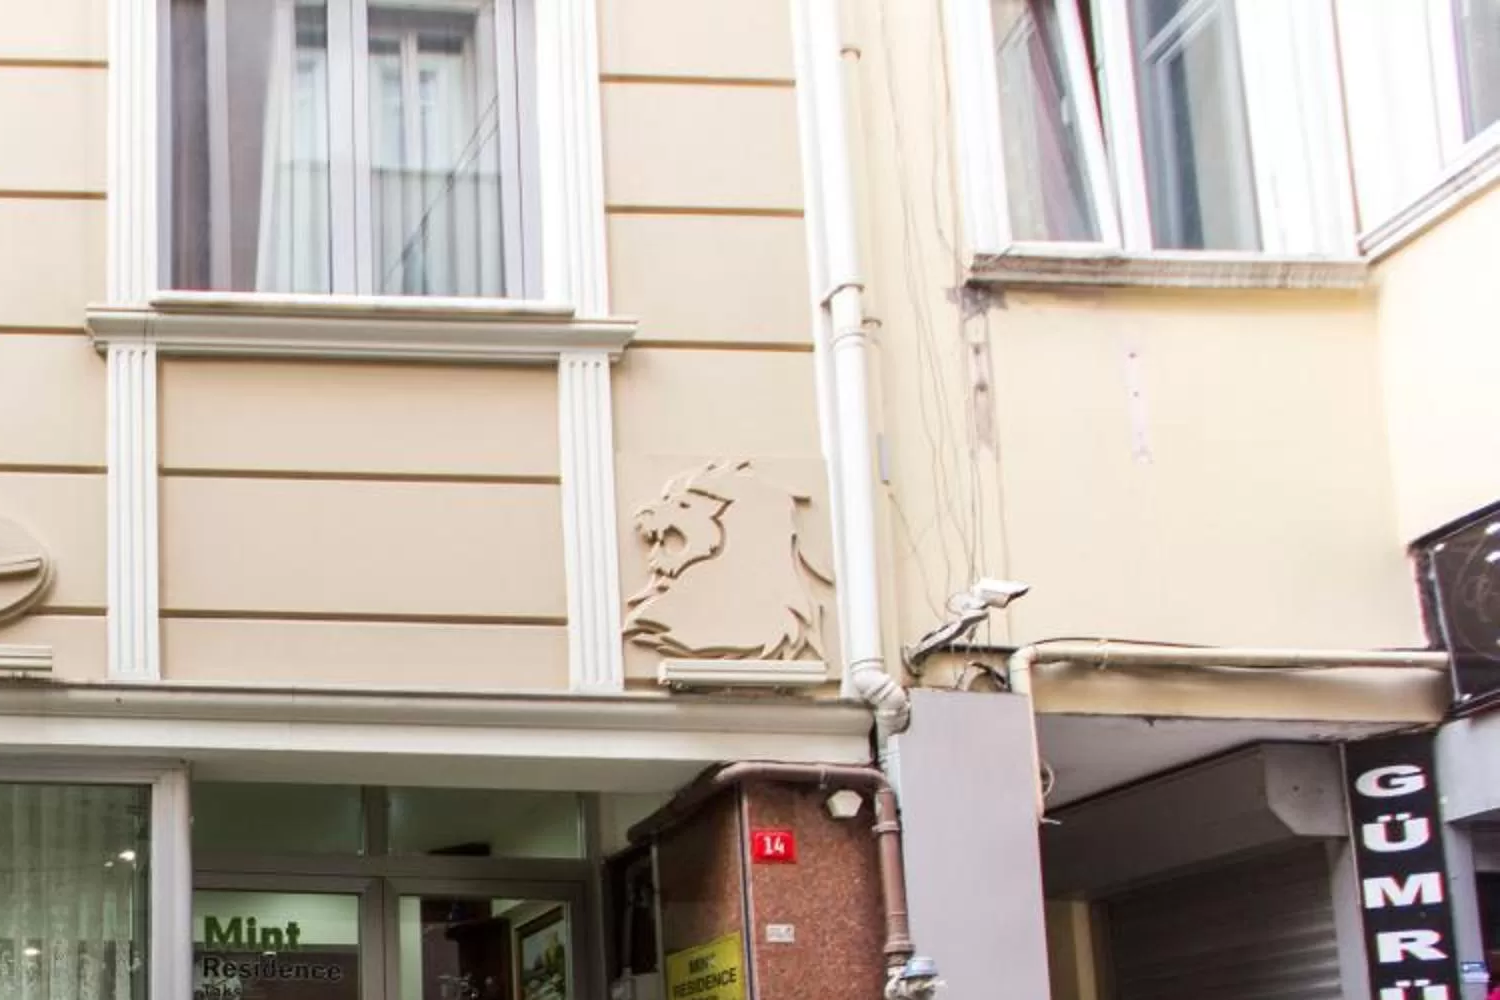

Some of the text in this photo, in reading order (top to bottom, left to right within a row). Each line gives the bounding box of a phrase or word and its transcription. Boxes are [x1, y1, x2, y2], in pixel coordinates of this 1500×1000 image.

[763, 835, 785, 856] 14
[204, 916, 301, 952] Mint
[203, 957, 342, 981] Residence
[672, 967, 737, 1000] RESIDENCE
